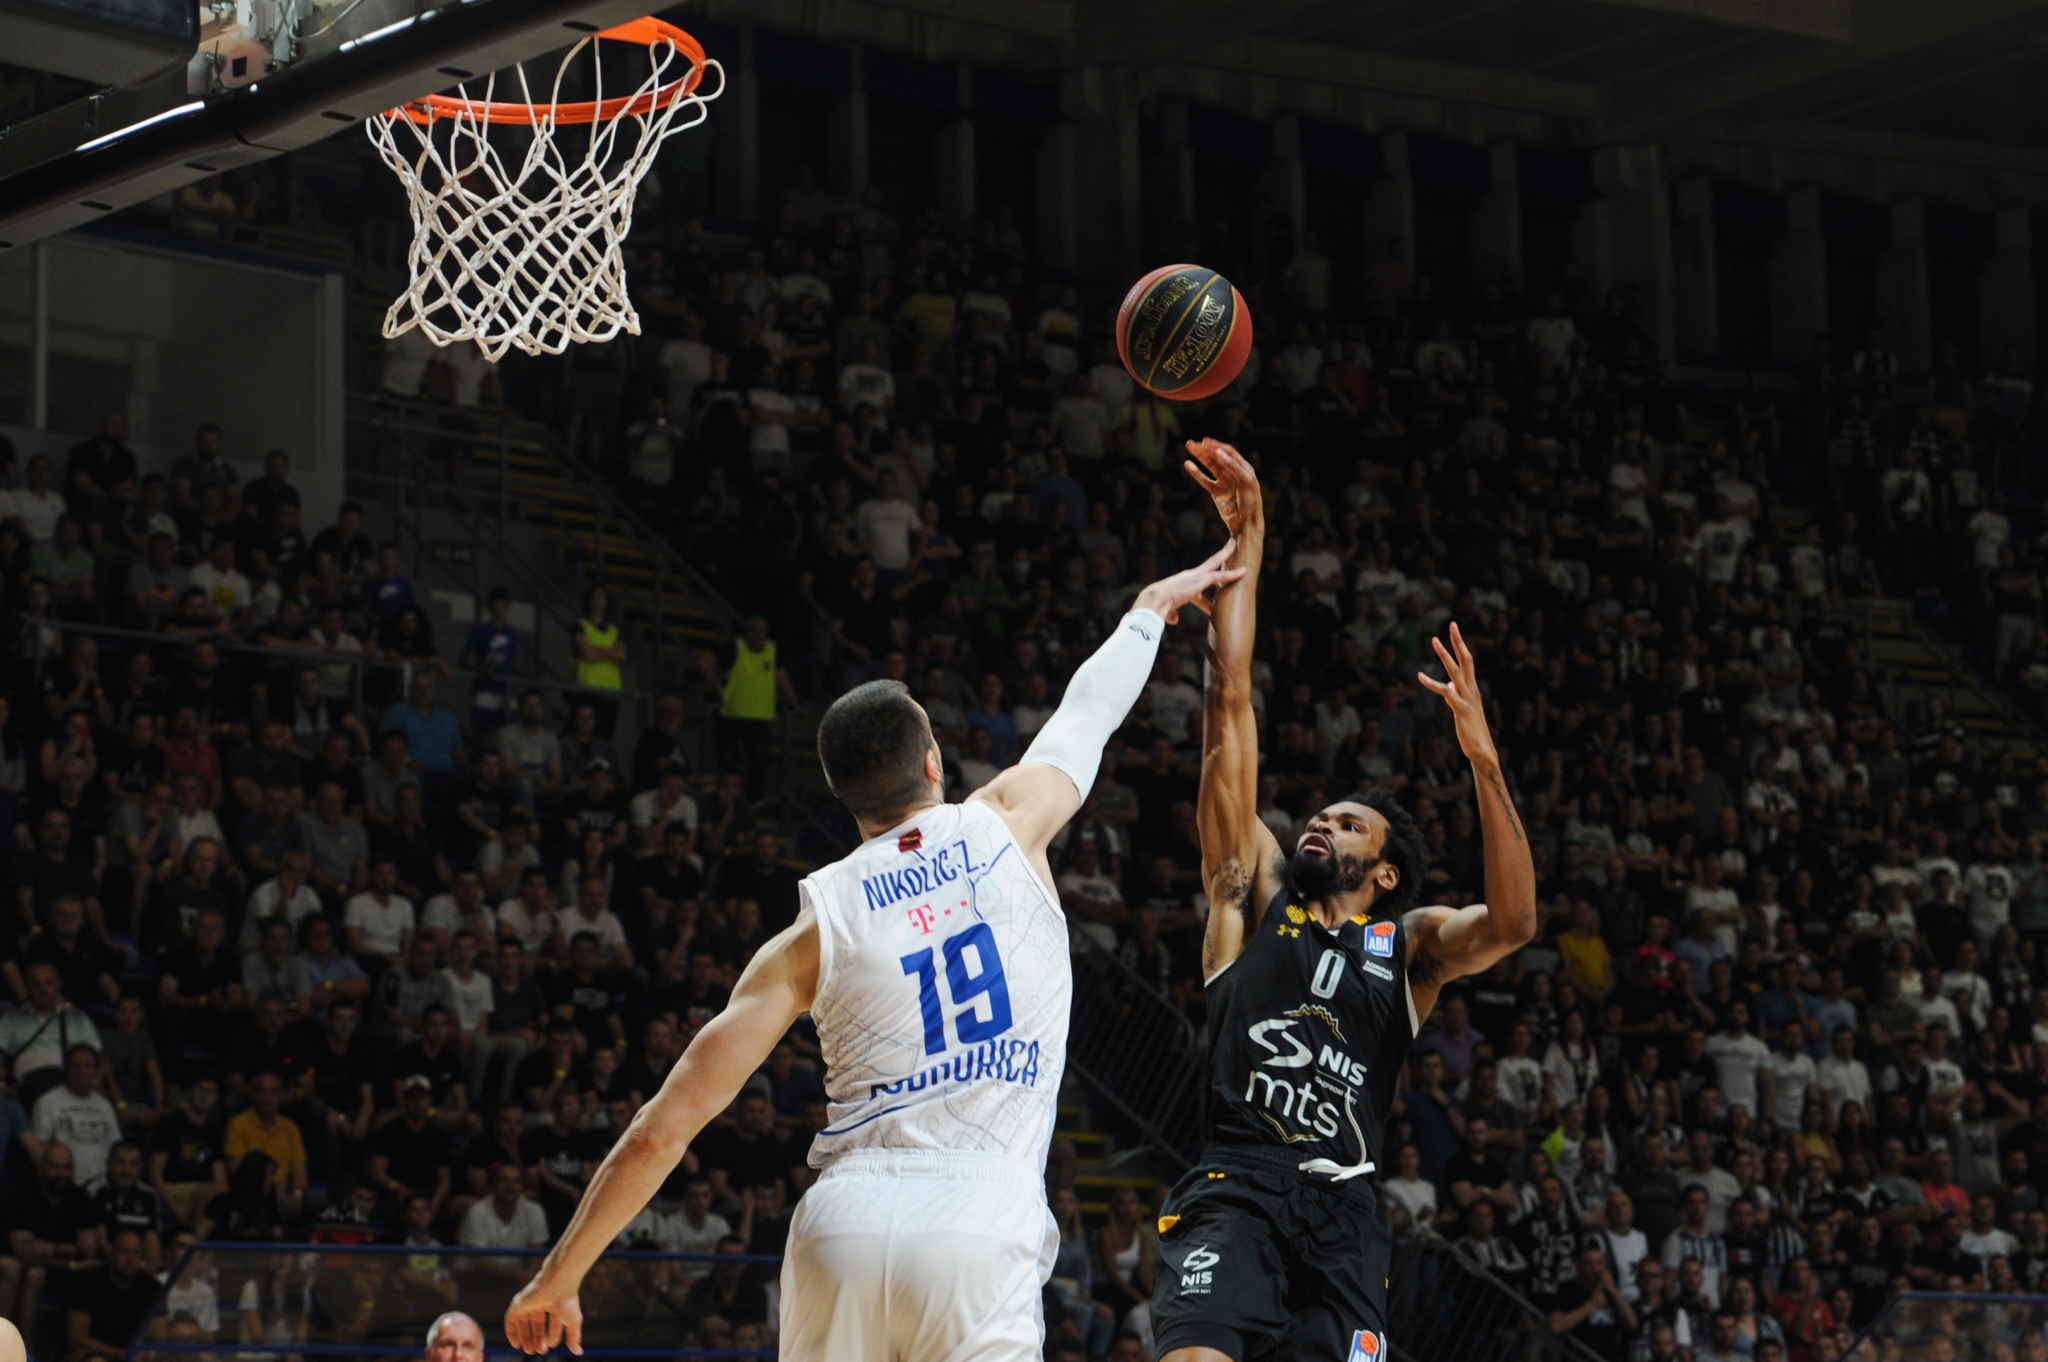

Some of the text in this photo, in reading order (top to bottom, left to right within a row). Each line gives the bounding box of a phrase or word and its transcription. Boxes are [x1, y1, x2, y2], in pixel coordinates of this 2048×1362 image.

[1134, 276, 1199, 361] SPALDING
[953, 839, 987, 874] Z.
[1368, 936, 1389, 953] ABA
[900, 922, 1013, 1056] 19
[1310, 948, 1347, 1000] 0
[1318, 1043, 1368, 1087] NIS
[1244, 1070, 1340, 1138] mts
[1181, 1270, 1213, 1287] NIS
